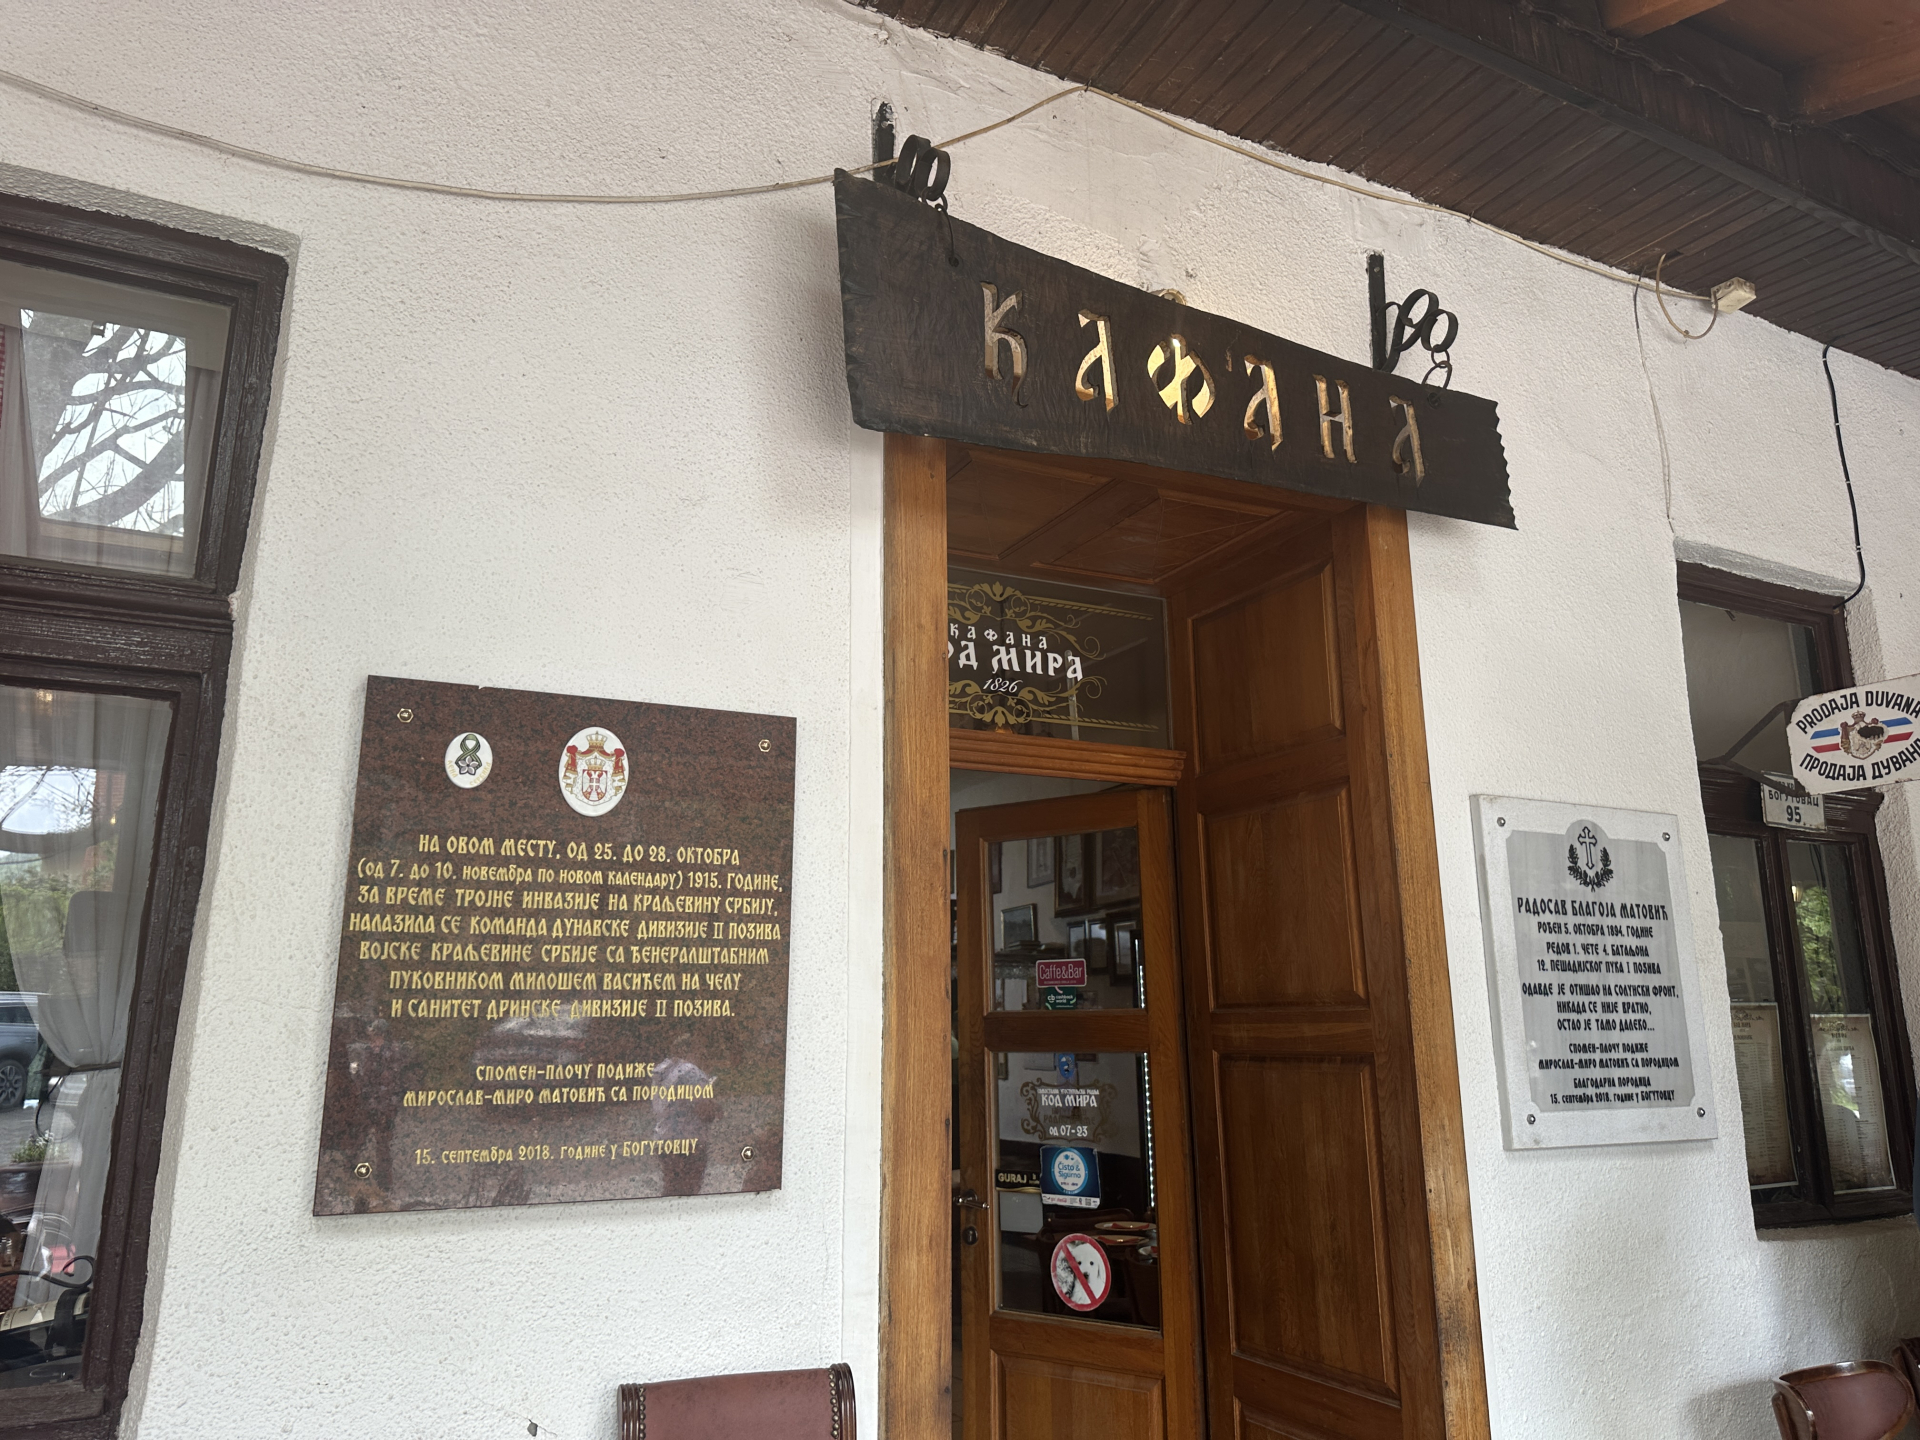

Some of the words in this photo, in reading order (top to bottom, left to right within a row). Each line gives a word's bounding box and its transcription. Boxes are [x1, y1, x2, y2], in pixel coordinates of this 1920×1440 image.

[991, 645, 1083, 681] МИРА
[982, 678, 1023, 693] 1826
[1795, 692, 1860, 735] PRODAJA
[1799, 752, 1867, 782] ПРОДАЈА
[1786, 804, 1802, 823] 95
[418, 834, 440, 853] НА
[446, 835, 495, 855] ОВОМ
[500, 838, 561, 859] МЕСТУ,
[566, 841, 588, 862] ОД
[594, 843, 617, 860] 25.
[622, 844, 644, 863] ДО
[649, 845, 671, 863] 28.
[676, 846, 740, 866] ОКТОБРА
[390, 859, 404, 878] 7.
[434, 861, 457, 880] 10.
[687, 871, 722, 889] 1915.
[726, 873, 783, 893] ГОДИНЕ,
[357, 885, 379, 904] ЗА
[385, 886, 446, 906] ВРЕМЕ
[455, 888, 514, 908] ТРОЈНЕ
[522, 891, 600, 911] ИНВАЗИЈЕ
[608, 893, 628, 911] НА
[633, 894, 721, 913] КРАЉЕВИНУ
[725, 896, 778, 917] СРБИЈУ,
[1517, 897, 1567, 917] РАДОСАВ
[1571, 900, 1617, 918] БЛАГОЈА
[1620, 902, 1668, 921] МАТОВИЋ
[349, 912, 435, 934] НАЛАЗИЛА
[440, 915, 461, 934] СЕ
[469, 916, 547, 938] КОМАНДА
[551, 918, 630, 939] ДУНАВСКЕ
[636, 920, 708, 940] ДИВИЗИЈЕ
[729, 922, 781, 940] ПОЗИВА
[1537, 921, 1562, 935] РОЂЕН
[1564, 923, 1571, 935] 5.
[1573, 923, 1605, 937] ОКТОБРА
[1606, 925, 1625, 937] 1894.
[1626, 925, 1653, 939] ГОДИНЕ
[359, 941, 422, 960] ВОЈСКЕ
[430, 942, 533, 963] КРАЉЕВИНЕ
[541, 944, 598, 964] СРБИЈЕ
[606, 945, 625, 963] СА
[630, 945, 769, 965] ЂЕНЕРАЛШТАБНИМ
[1546, 941, 1571, 956] РЕДОВ
[1572, 943, 1580, 955] 1.
[1581, 943, 1599, 956] ЧЕТЕ
[1602, 944, 1610, 956] 4.
[1611, 944, 1650, 957] БАТАЉОНА
[1039, 963, 1083, 980] Caffe&Bar
[1537, 959, 1548, 972] 12.
[1550, 959, 1603, 974] ПЕШАДИЈСКОГ
[1605, 961, 1624, 974] ПУКА
[1633, 962, 1662, 975] ПОЗИВА
[389, 970, 504, 990] ПУКОВНИКОМ
[509, 971, 598, 990] МИЛОШЕМ
[602, 972, 676, 991] ВАСИЋЕМ
[681, 973, 700, 991] НА
[705, 972, 742, 991] ЧЕЛУ
[1522, 982, 1553, 997] ОДАВДЕ
[1557, 983, 1566, 995] ЈЕ
[1569, 983, 1600, 996] ОТИШАО
[1602, 984, 1612, 996] НА
[1614, 984, 1650, 997] СОЛУНСКИ
[1652, 985, 1679, 998] ФРОНТ,
[390, 998, 403, 1018] И
[408, 998, 482, 1018] САНИТЕТ
[485, 998, 562, 1020] ДРИНСКЕ
[570, 999, 648, 1019] ДИВИЗИЈЕ
[673, 999, 735, 1018] ПОЗИВА.
[1556, 1001, 1587, 1015] НИКАДА
[1588, 1001, 1598, 1014] СЕ
[1601, 1001, 1619, 1014] НИЈЕ
[1622, 1002, 1652, 1015] ВРАТИО,
[1557, 1018, 1581, 1031] ОСТАО
[1584, 1018, 1592, 1031] ЈЕ
[1594, 1018, 1617, 1031] ТАМО
[1619, 1018, 1655, 1032] ДАЛЕКО...
[1568, 1042, 1620, 1054] СПОМЕН-ПЛОЧУ
[1622, 1042, 1649, 1054] ПОДИЖЕ
[475, 1063, 593, 1081] СПОМЕН-ПЛОЧУ
[597, 1062, 655, 1080] ПОДИЖЕ
[1538, 1058, 1597, 1070] МИРОСЛАВ-МИРО
[1599, 1057, 1630, 1068] МАТОВИЋ
[1631, 1057, 1640, 1068] СА
[1641, 1057, 1680, 1069] ПОРОДИЦОМ
[1573, 1077, 1616, 1089] БЛАГОДАРНА
[1618, 1076, 1651, 1088] ПОРОДИЦА
[403, 1087, 534, 1107] МИРОСЛАВ-МИРО
[538, 1086, 606, 1104] МАТОВИЋ
[610, 1086, 628, 1102] СА
[632, 1084, 714, 1102] ПОРОДИЦОМ
[1041, 1094, 1063, 1108] КОД
[1064, 1094, 1098, 1108] МИРА
[1550, 1093, 1561, 1104] 15.
[1595, 1091, 1612, 1103] 2018.
[1640, 1090, 1675, 1102] БОГУТОВЦУ
[414, 1148, 435, 1165] 15.
[518, 1144, 554, 1161] 2018.
[622, 1138, 698, 1157] БОГУТОВЦУ
[1058, 1161, 1075, 1172] Čisto
[1058, 1171, 1082, 1180] Sigurno
[998, 1172, 1027, 1184] GURAJ
